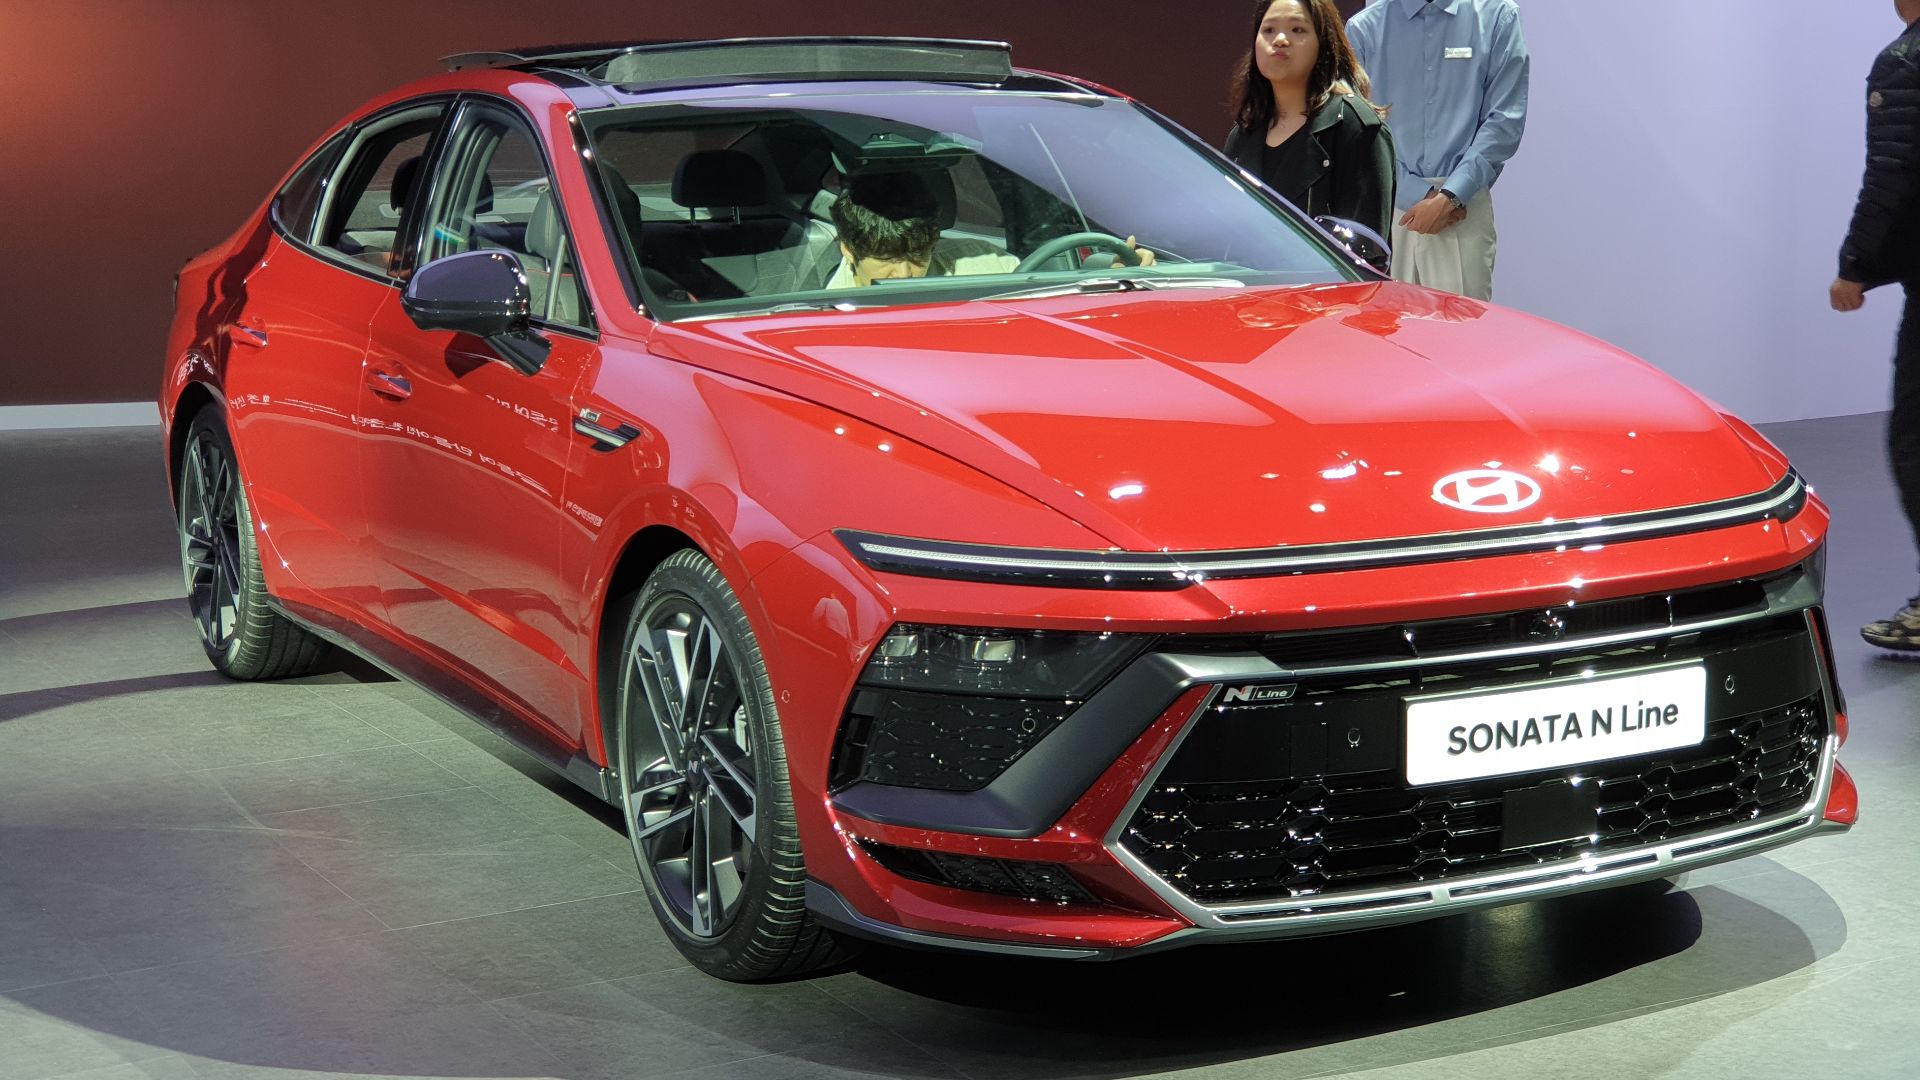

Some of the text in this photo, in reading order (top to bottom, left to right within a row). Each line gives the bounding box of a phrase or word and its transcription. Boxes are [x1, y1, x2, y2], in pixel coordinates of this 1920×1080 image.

[1223, 685, 1288, 702] N Line
[1448, 699, 1679, 756] SONATA N Line
